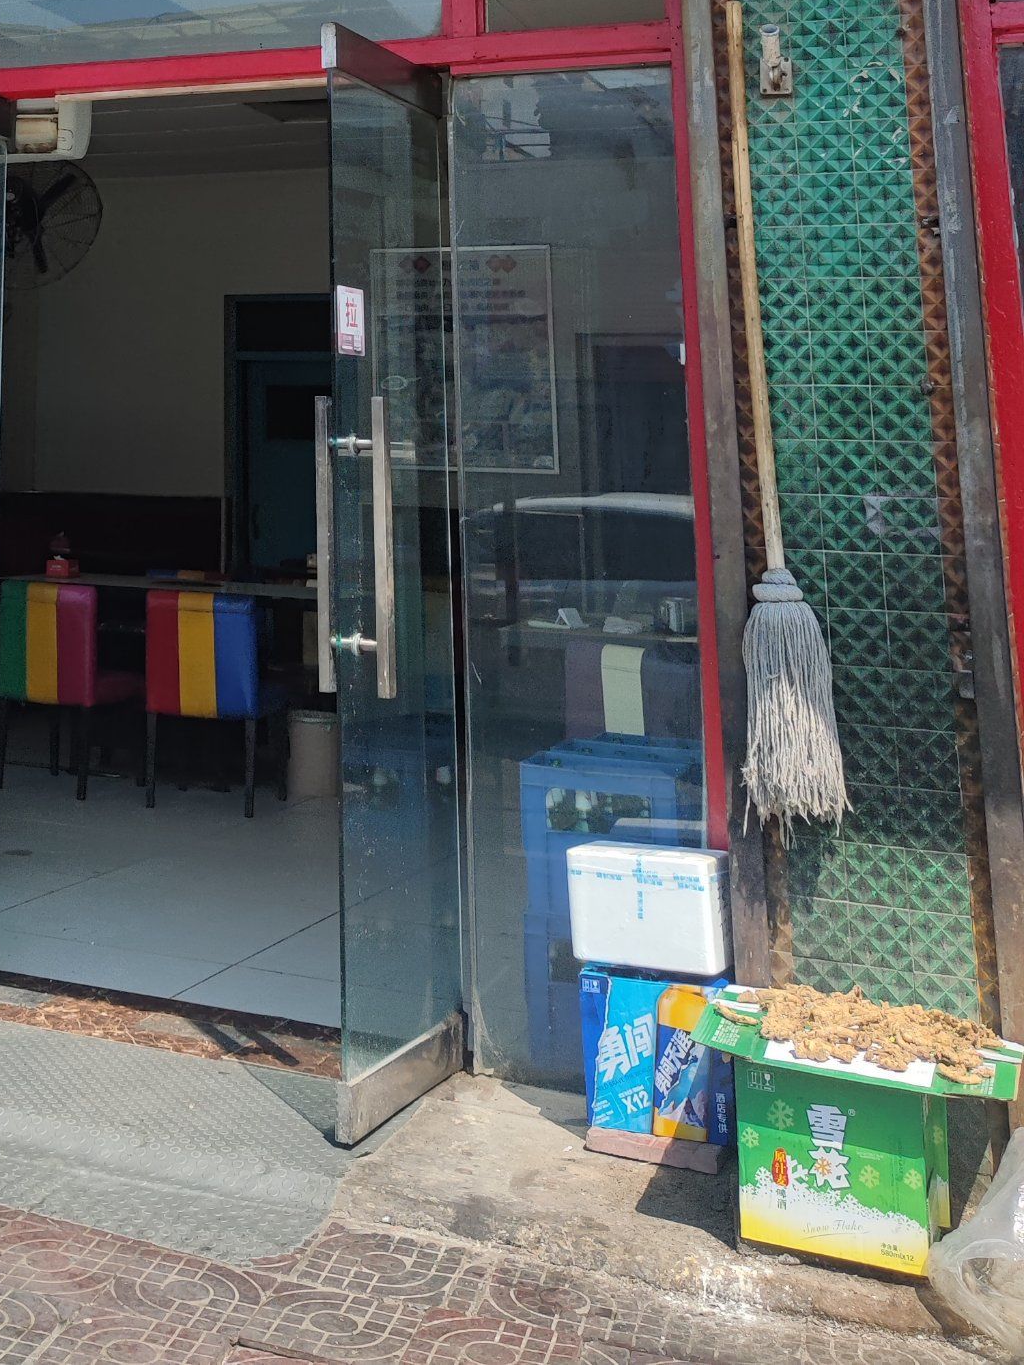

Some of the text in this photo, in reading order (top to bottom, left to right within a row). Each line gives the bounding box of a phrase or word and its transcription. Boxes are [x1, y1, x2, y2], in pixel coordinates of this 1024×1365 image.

[345, 296, 359, 328] 拉
[598, 1013, 656, 1083] 勇闯
[715, 1092, 728, 1134] 酒店专供
[806, 1103, 852, 1190] 雪花
